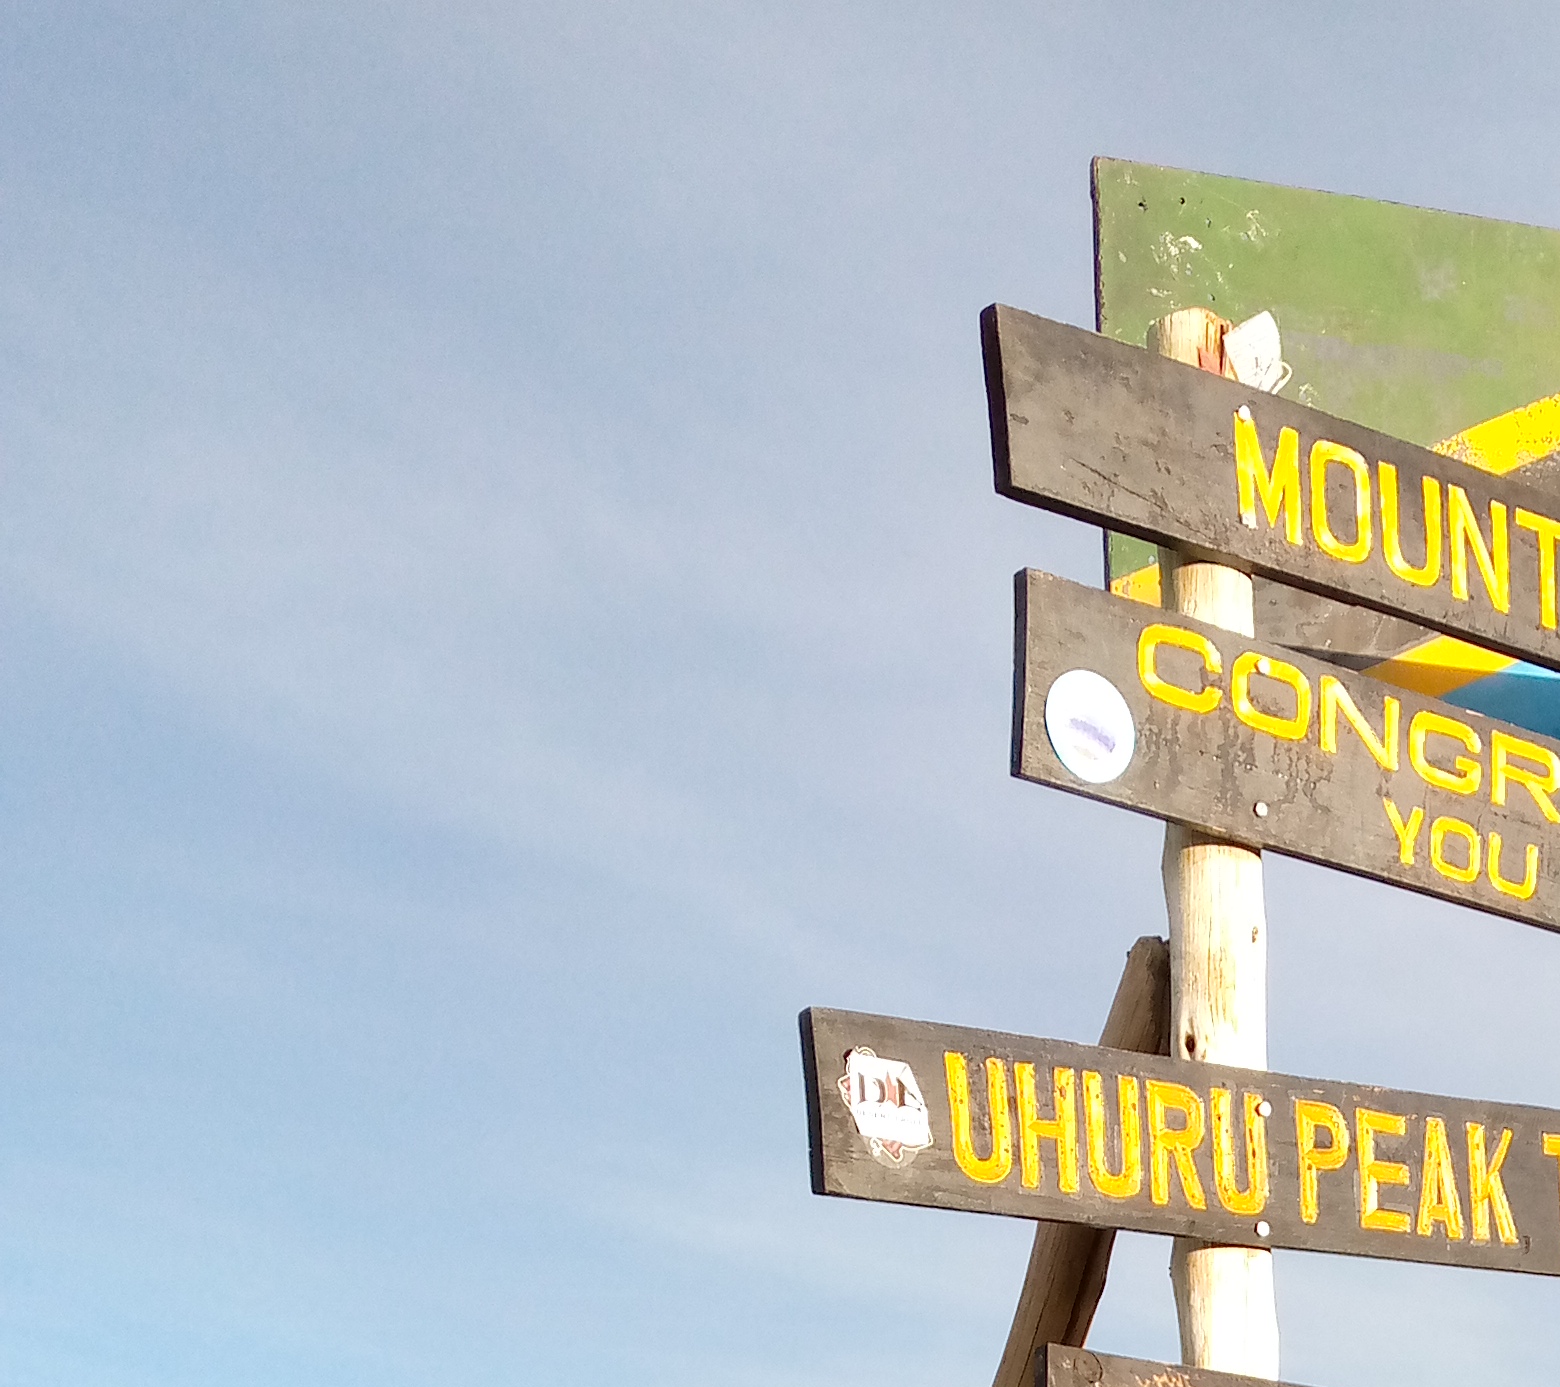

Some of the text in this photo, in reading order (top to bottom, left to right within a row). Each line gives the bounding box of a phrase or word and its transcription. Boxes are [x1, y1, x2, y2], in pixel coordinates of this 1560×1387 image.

[1384, 797, 1540, 886] YOU
[942, 1049, 1269, 1217] UHURU
[1294, 1098, 1517, 1245] PEAK
